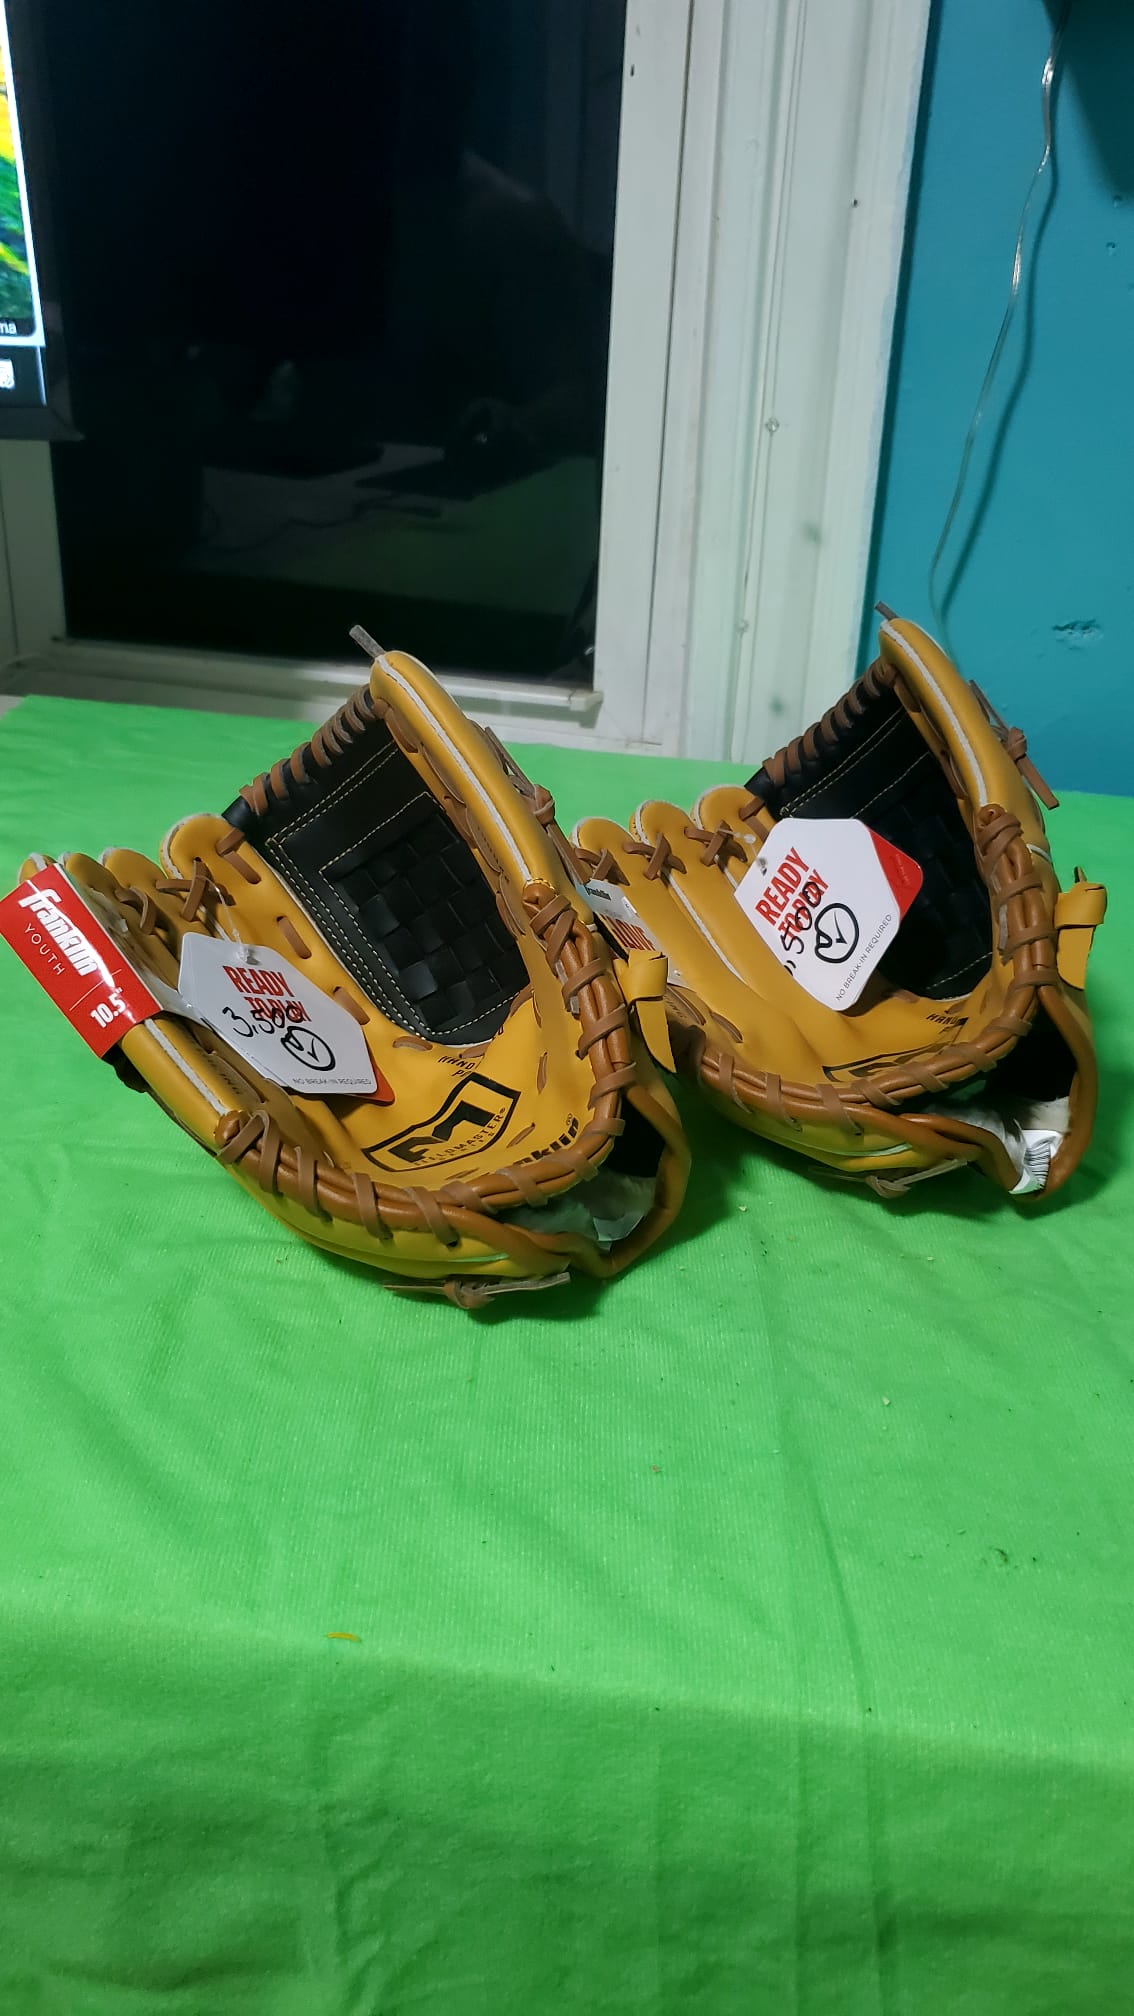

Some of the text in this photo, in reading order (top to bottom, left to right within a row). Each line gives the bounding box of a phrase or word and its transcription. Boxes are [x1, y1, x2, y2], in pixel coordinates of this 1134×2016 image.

[755, 847, 809, 926] READY
[24, 922, 66, 976] YOUTH
[222, 965, 295, 997] READY
[835, 988, 846, 1001] NO
[865, 914, 892, 953] REQUIRED
